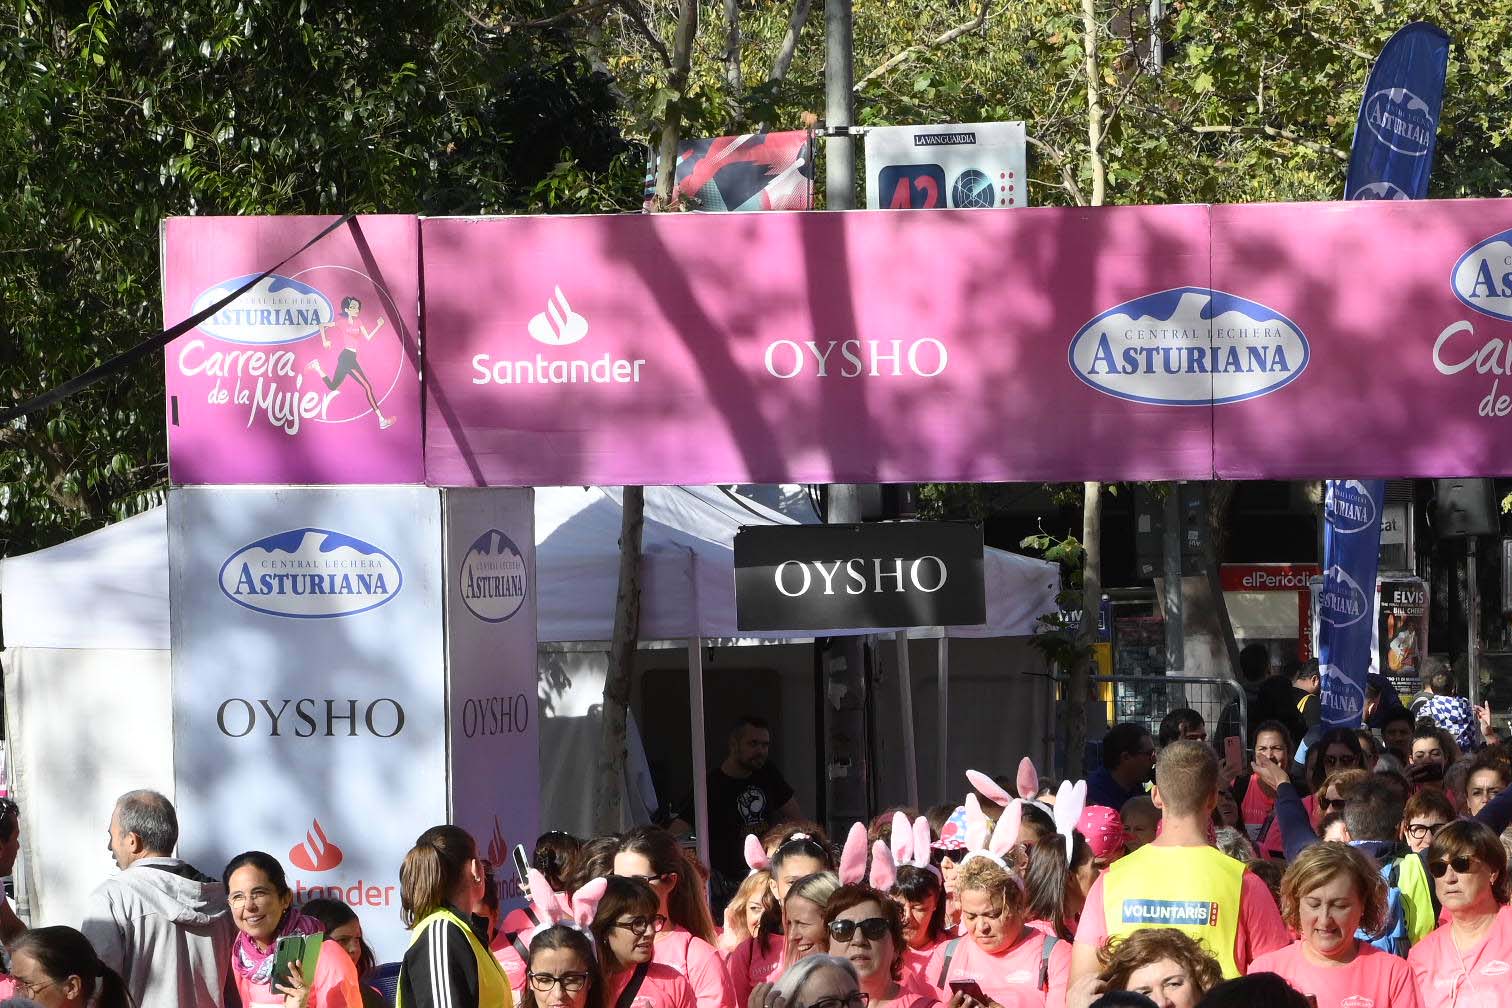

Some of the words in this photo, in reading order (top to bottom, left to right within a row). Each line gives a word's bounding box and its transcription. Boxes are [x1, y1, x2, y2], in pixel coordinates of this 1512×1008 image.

[915, 135, 926, 145] LA
[926, 133, 975, 145] VANGUARDIA
[889, 175, 939, 208] 42
[1125, 328, 1199, 340] CENTRAL
[1207, 327, 1283, 339] LECHERA
[179, 340, 296, 377] Carrera
[472, 352, 646, 385] Santander
[764, 337, 948, 379] OYSHO
[1088, 332, 1291, 376] ASTURIANA
[208, 379, 230, 405] de
[233, 380, 251, 405] la
[247, 374, 341, 436] Mujer
[1478, 377, 1512, 418] de
[233, 562, 389, 597] ASTURIANA
[261, 560, 319, 570] CENTRAL
[325, 560, 383, 569] LECHERA
[465, 564, 524, 600] ASTURIANA
[774, 555, 947, 597] OYSHO
[1242, 571, 1312, 587] elPeriódi
[1393, 591, 1424, 604] ELVIS
[216, 698, 405, 738] OYSHO
[462, 694, 529, 738] OYSHO
[295, 880, 395, 907] tander
[1123, 903, 1208, 920] VOLUNTARIS
